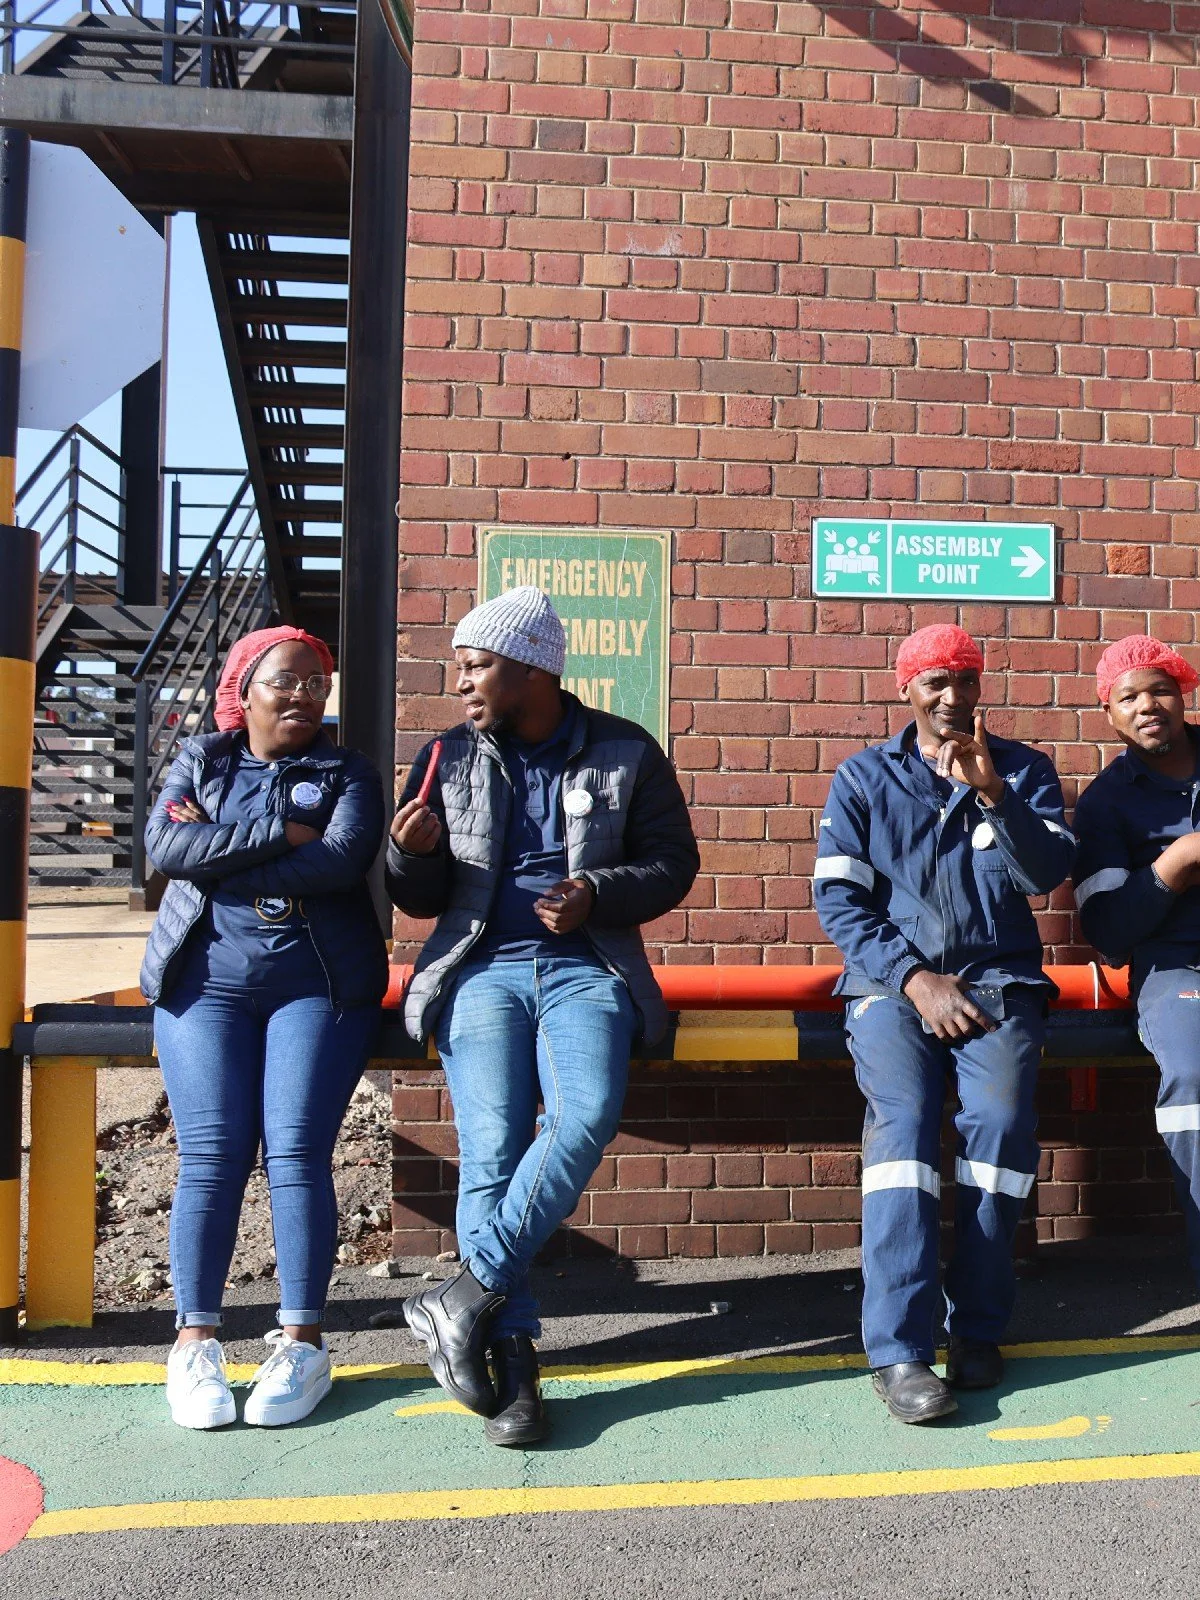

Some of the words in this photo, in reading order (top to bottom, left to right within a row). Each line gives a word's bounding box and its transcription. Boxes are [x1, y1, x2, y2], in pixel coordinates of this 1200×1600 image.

[895, 535, 1003, 558] ASSEMBLY
[501, 557, 647, 598] EMERGENCY
[918, 563, 981, 585] POINT
